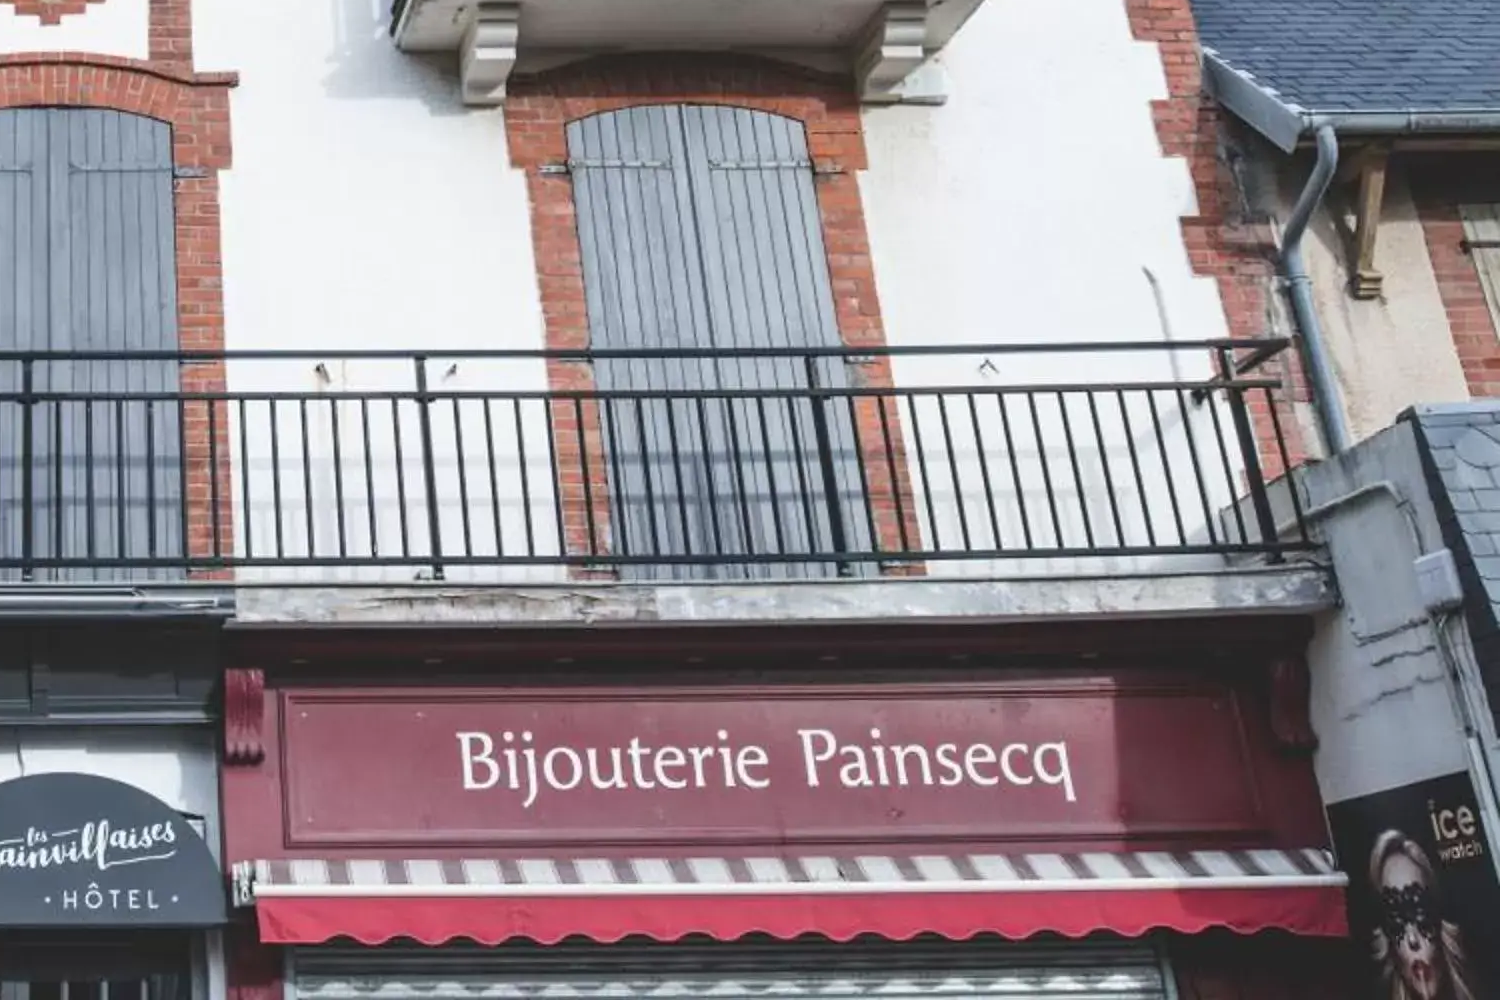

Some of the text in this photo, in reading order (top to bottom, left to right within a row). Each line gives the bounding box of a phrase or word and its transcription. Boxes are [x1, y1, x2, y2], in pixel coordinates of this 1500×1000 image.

[456, 727, 1077, 807] Bijouterie Painsecq
[1427, 799, 1476, 841] ice
[26, 826, 48, 847] les
[1439, 840, 1483, 860] watch
[62, 882, 160, 910] HÔTEL
